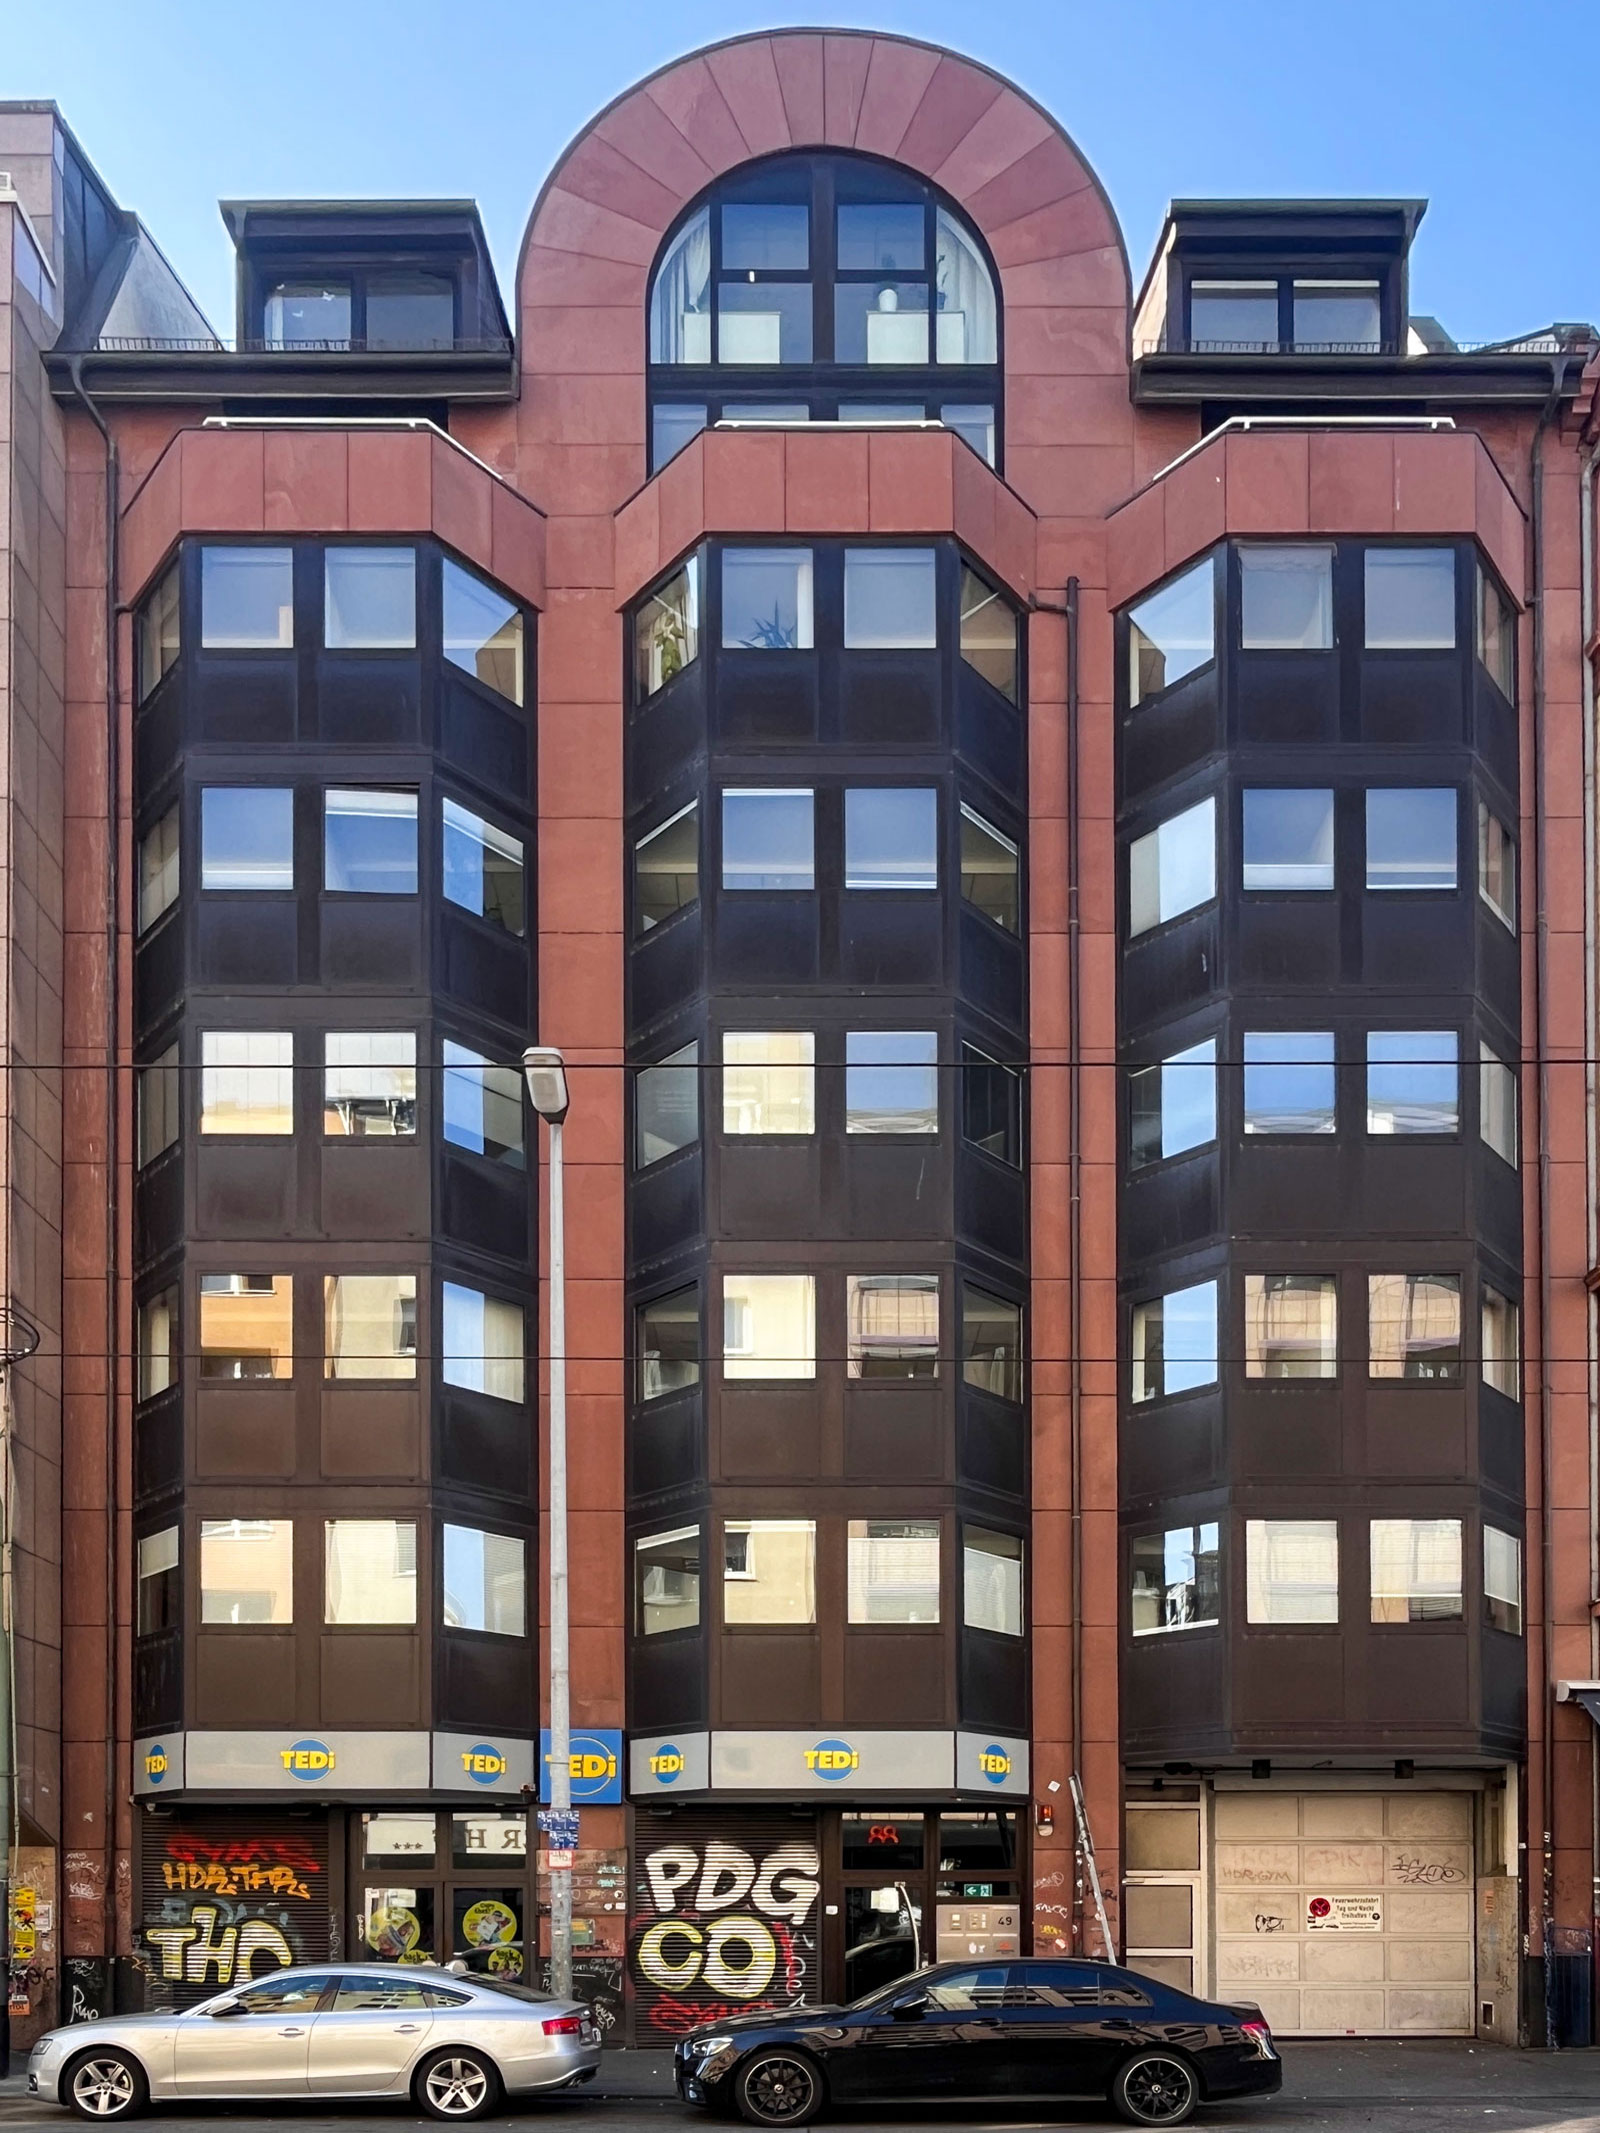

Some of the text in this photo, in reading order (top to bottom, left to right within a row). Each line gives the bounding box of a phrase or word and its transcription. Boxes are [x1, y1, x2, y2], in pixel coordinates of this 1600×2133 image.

[145, 1755, 168, 1774] TEDi
[280, 1751, 336, 1769] TEDi
[461, 1753, 506, 1774] TEDi
[545, 1754, 617, 1778] EDi
[649, 1755, 684, 1774] TEDi
[804, 1751, 859, 1769] TEDi
[979, 1753, 1011, 1774] TEDi
[645, 1841, 820, 1925] PDG
[998, 1916, 1012, 1926] 49
[639, 1915, 776, 1998] CO
